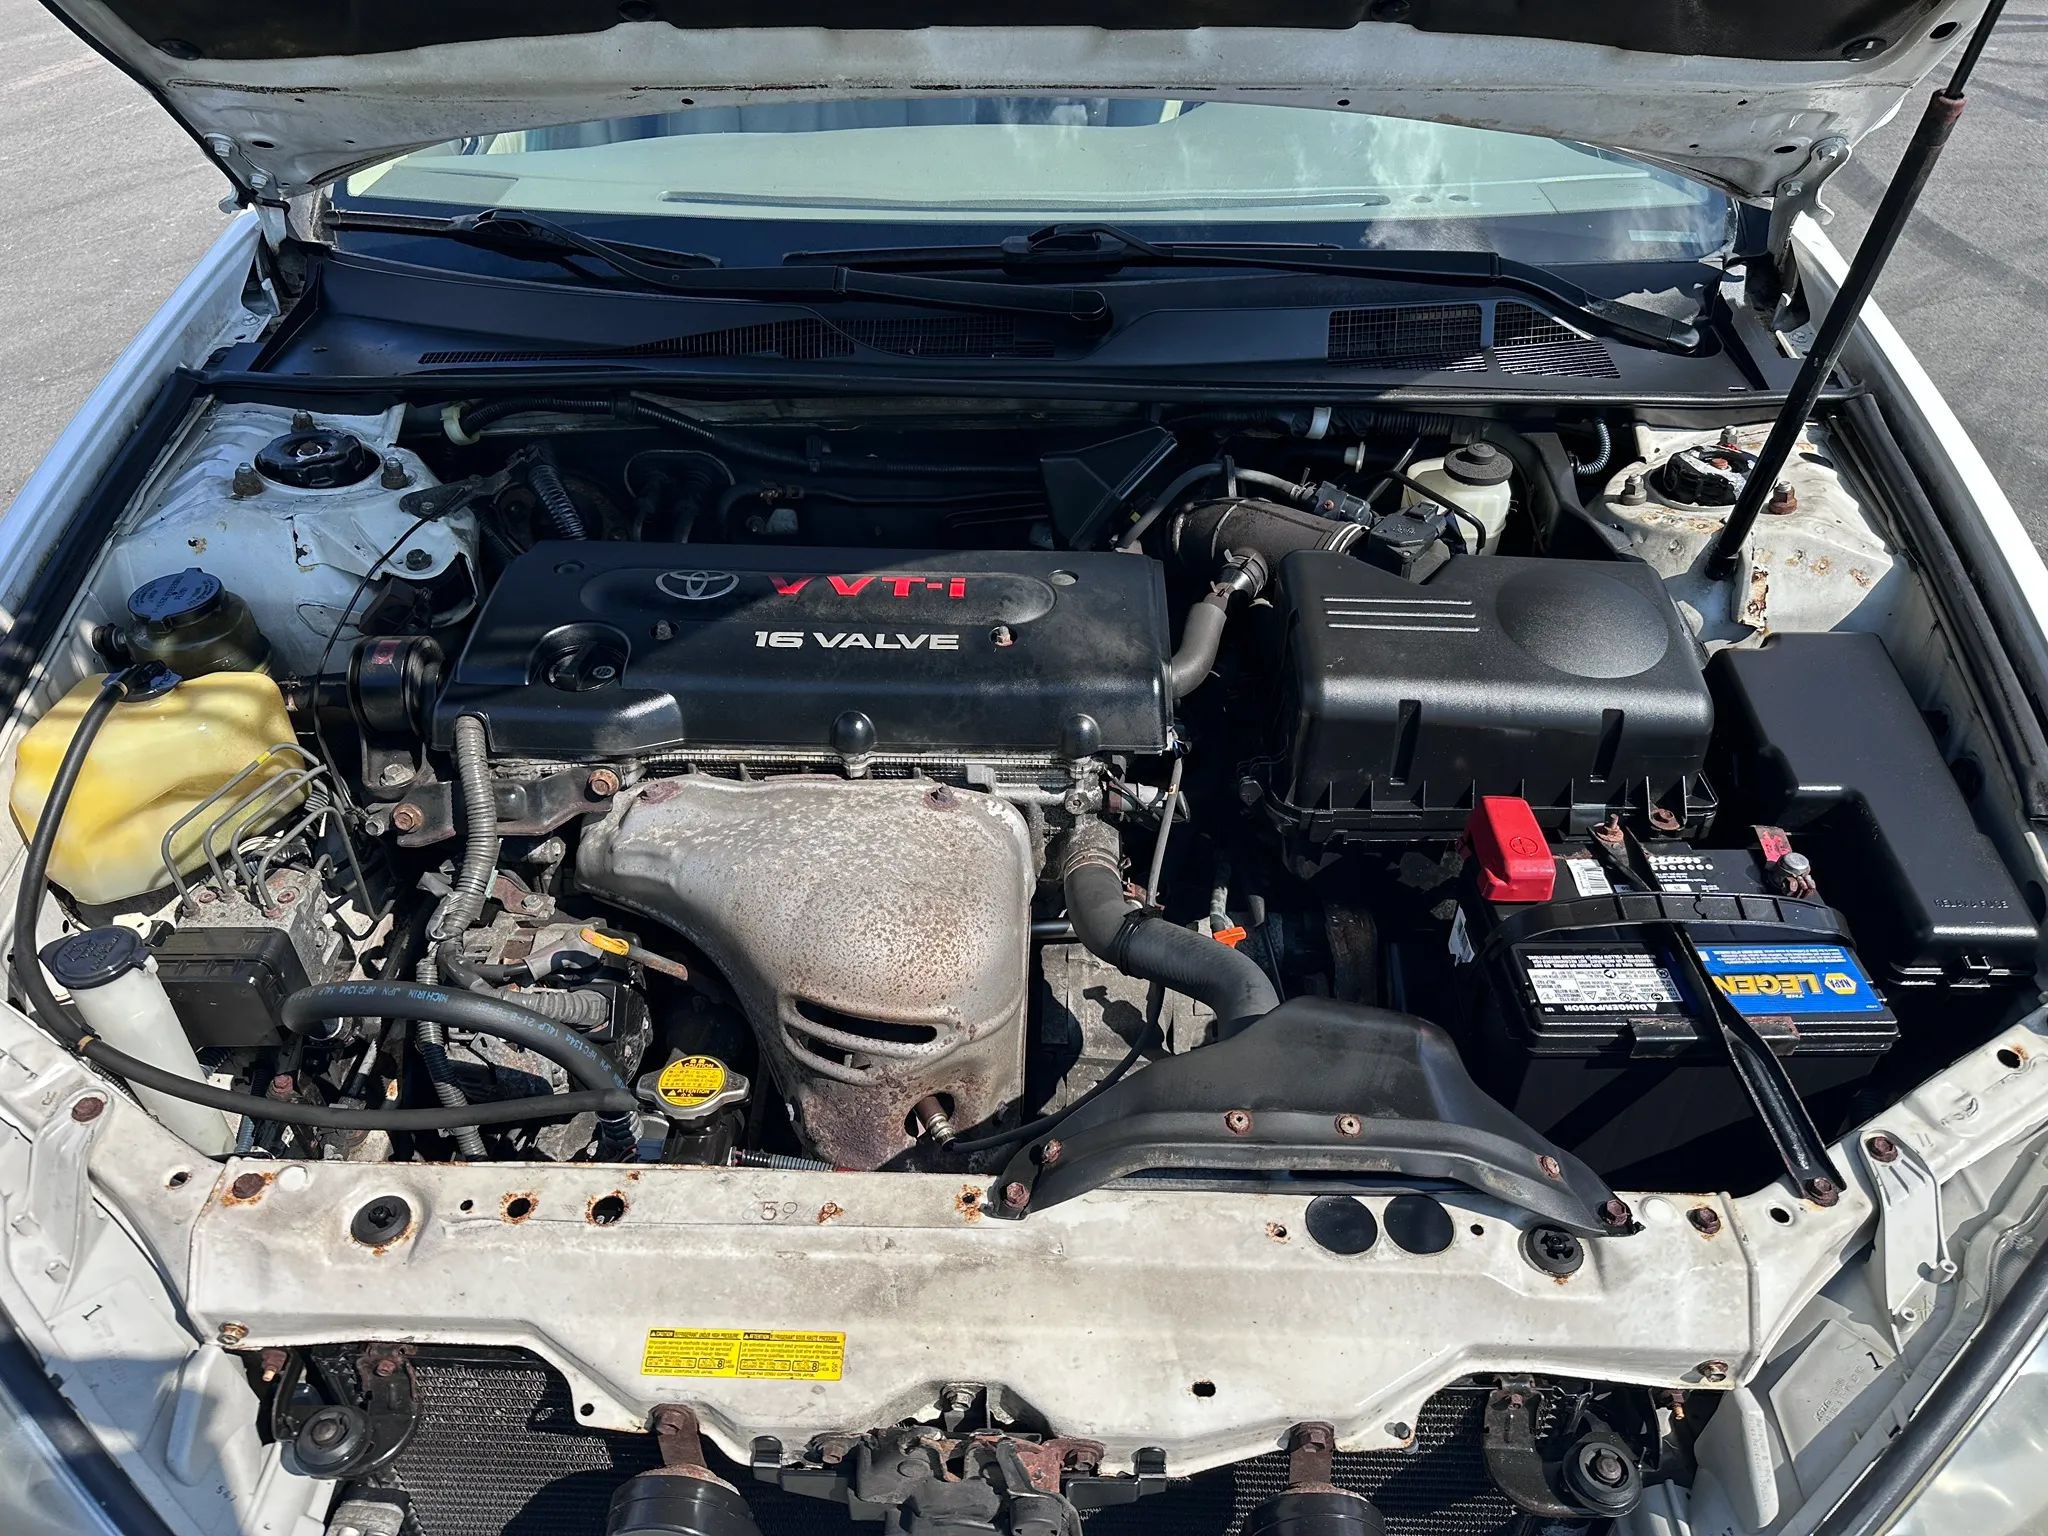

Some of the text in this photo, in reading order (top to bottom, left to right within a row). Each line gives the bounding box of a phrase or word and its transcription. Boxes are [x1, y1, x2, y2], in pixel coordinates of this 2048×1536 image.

[754, 630, 960, 651] 16 VALVE
[1711, 973, 1823, 995] LEGEN
[1829, 978, 1852, 989] NAPA
